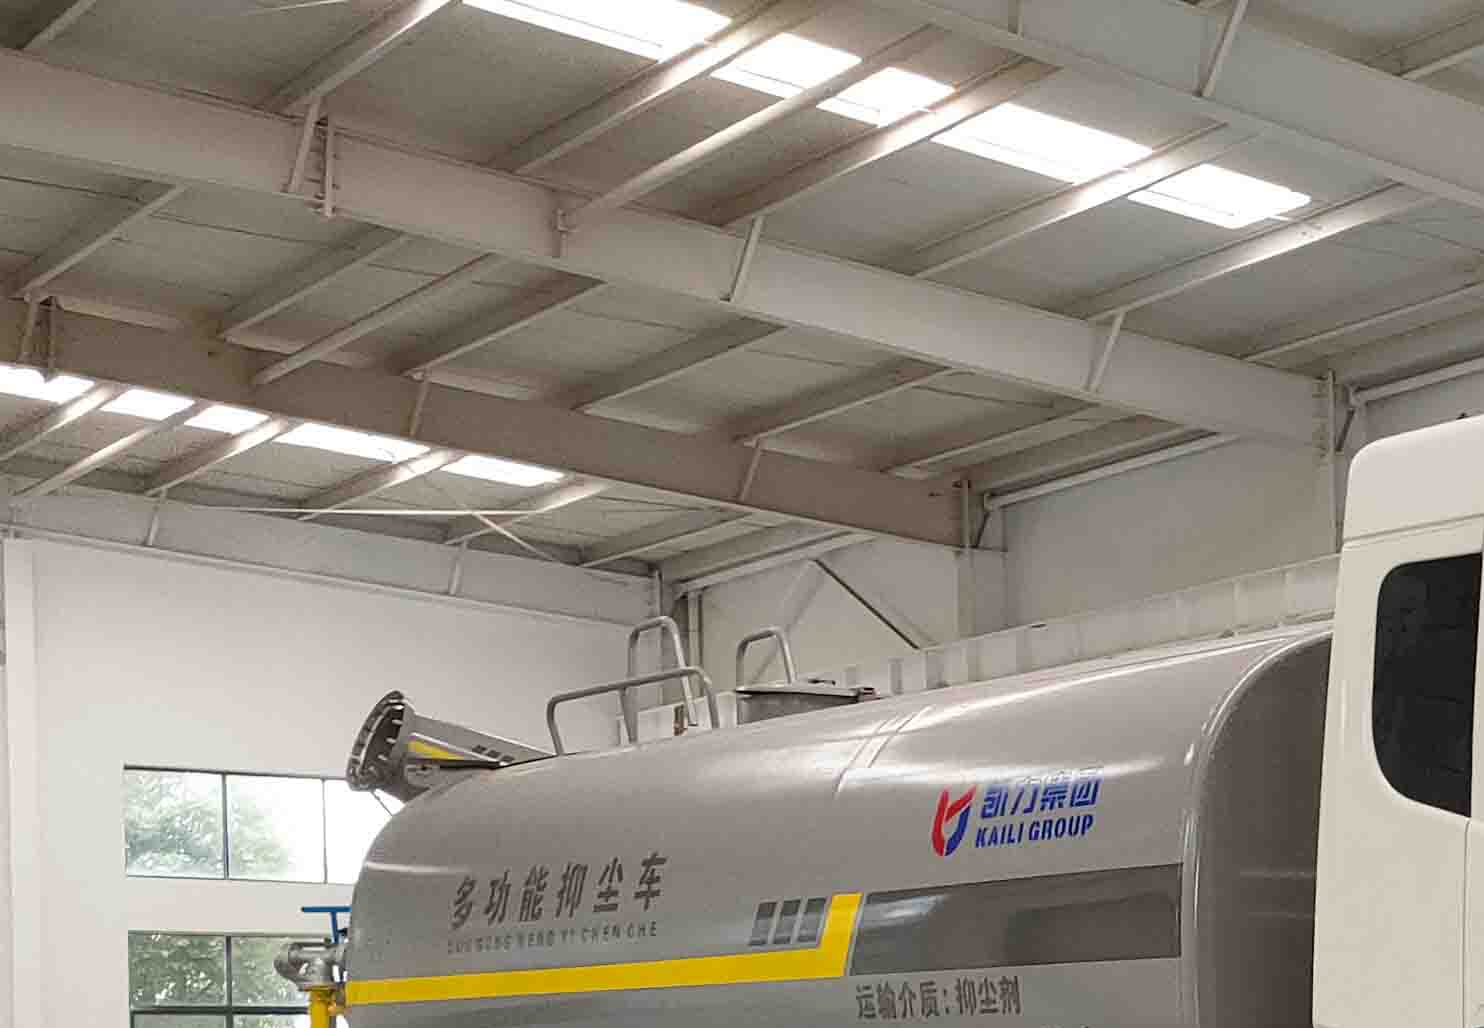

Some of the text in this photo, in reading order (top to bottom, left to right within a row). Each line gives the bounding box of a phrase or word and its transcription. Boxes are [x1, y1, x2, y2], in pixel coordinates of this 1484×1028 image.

[975, 814, 1095, 848] KAILI GROUP
[450, 851, 668, 930] 多功能抑尘车
